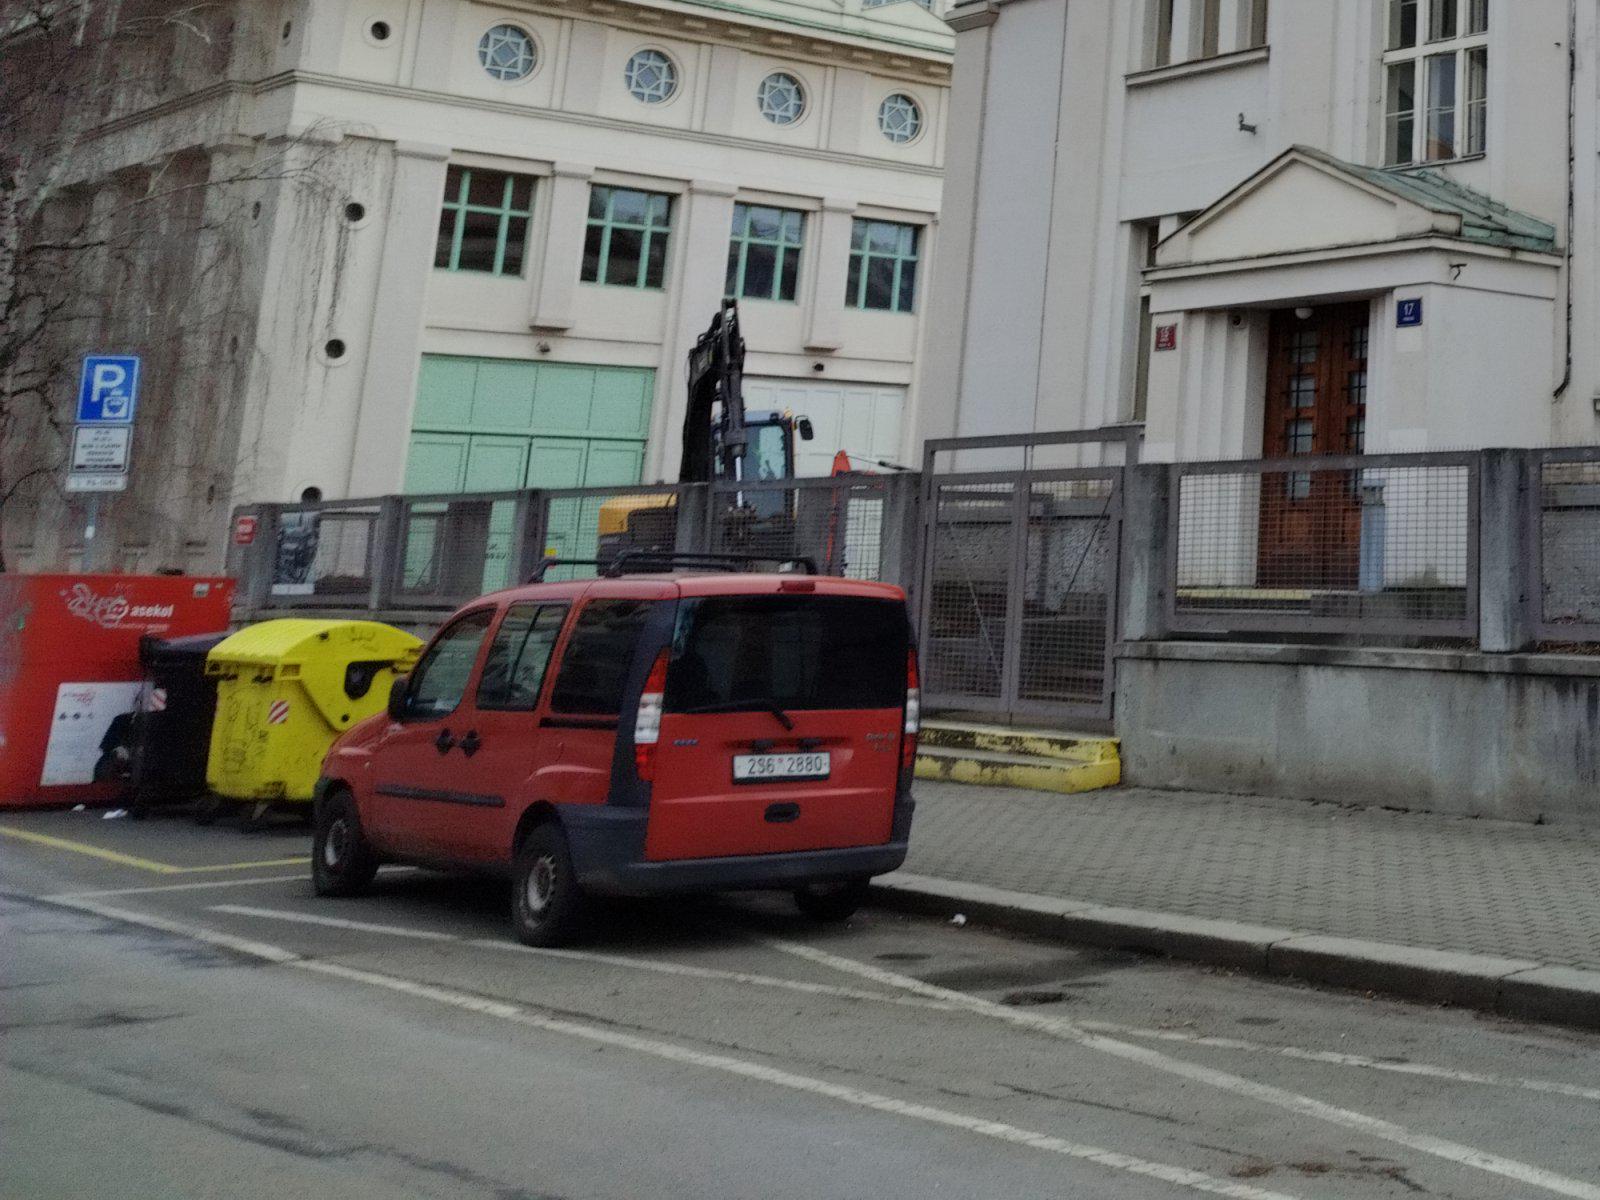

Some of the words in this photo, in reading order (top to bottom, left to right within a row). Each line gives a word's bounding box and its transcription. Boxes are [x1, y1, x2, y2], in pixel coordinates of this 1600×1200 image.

[1404, 302, 1415, 316] 17
[91, 364, 126, 403] P
[129, 604, 174, 618] asekol
[786, 756, 823, 774] 2880
